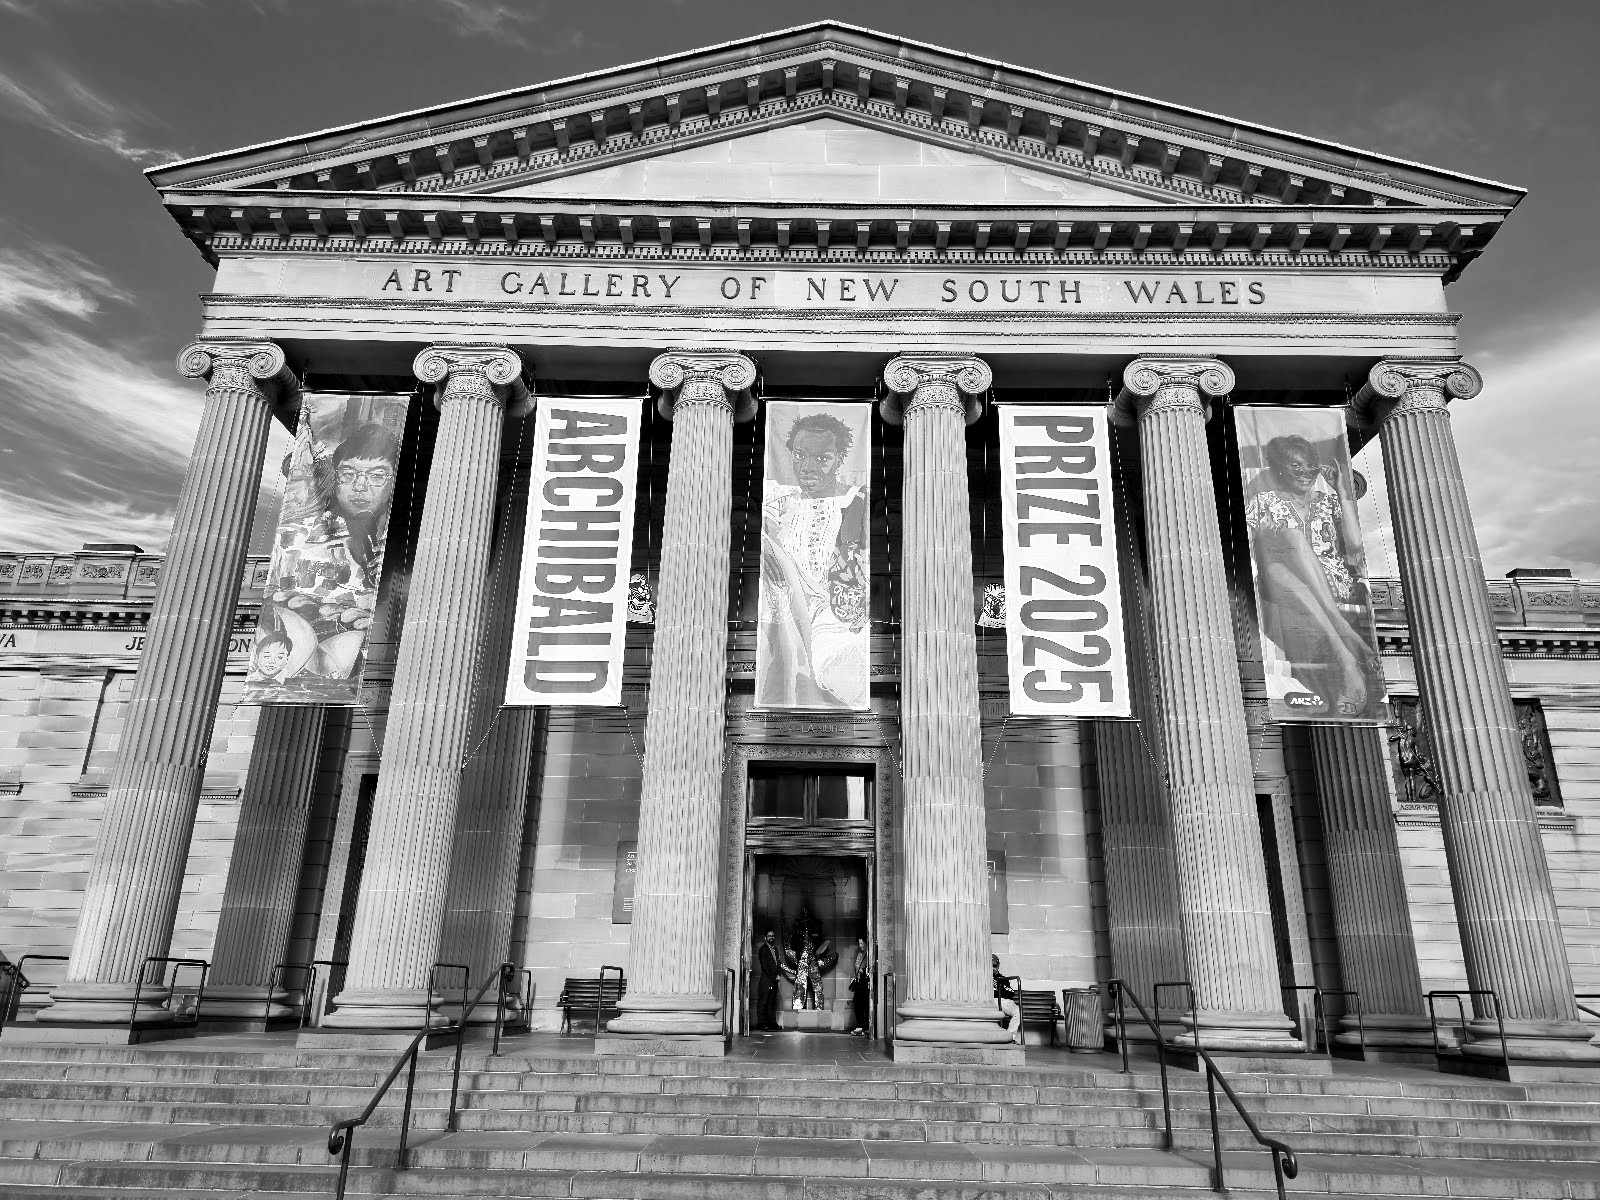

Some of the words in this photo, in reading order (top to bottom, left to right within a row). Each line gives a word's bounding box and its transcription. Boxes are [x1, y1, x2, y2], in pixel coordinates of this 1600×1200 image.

[382, 268, 462, 293] ART
[500, 271, 681, 299] GALLERY
[720, 276, 767, 300] OF
[806, 277, 899, 302] NEW
[941, 278, 1083, 303] SOUTH
[1124, 280, 1267, 305] WALES
[1013, 415, 1103, 548] PRIZE
[523, 408, 628, 694] ARCHIBALD
[1019, 564, 1114, 704] 2025
